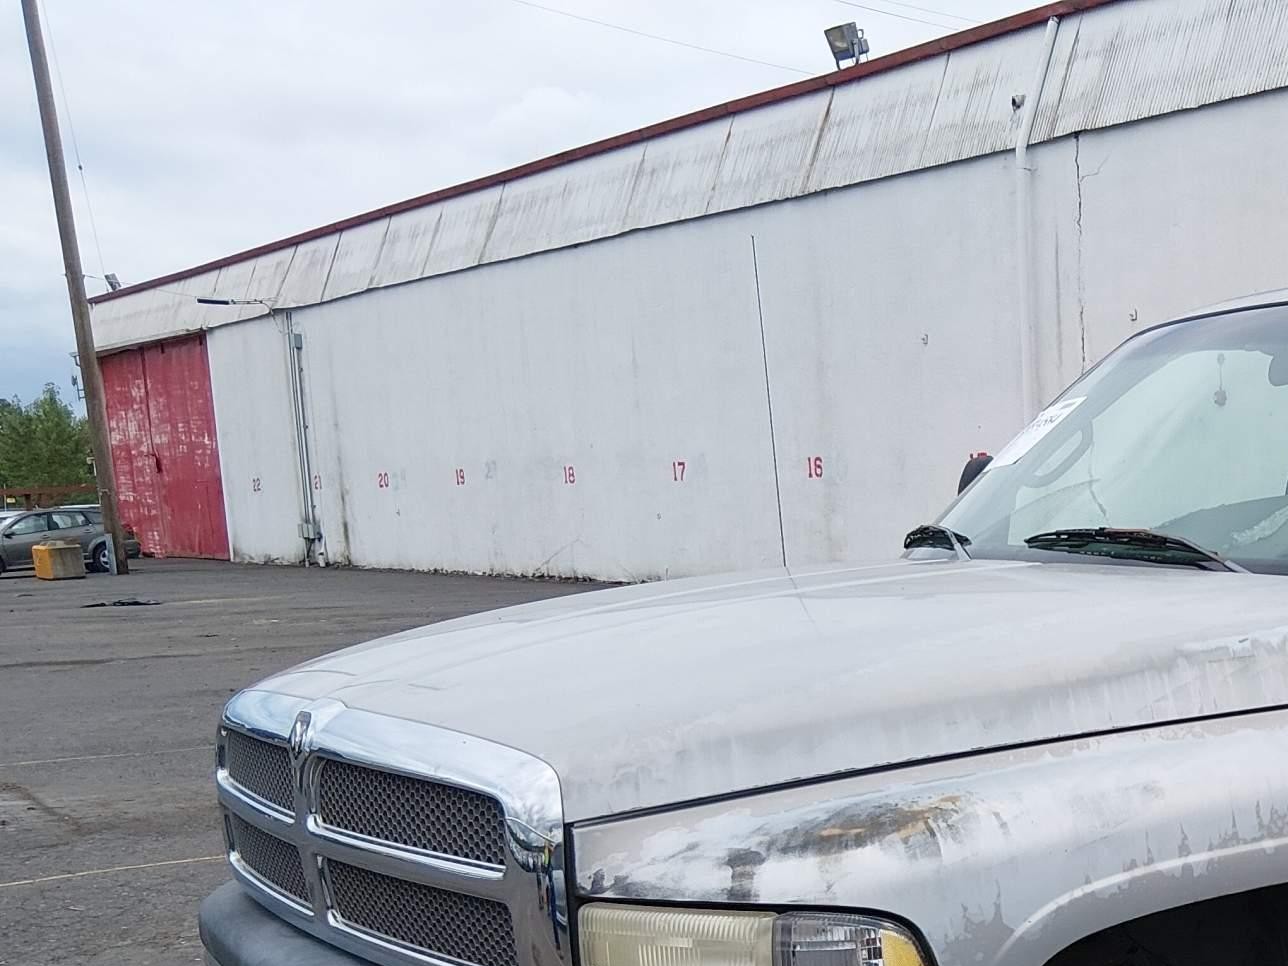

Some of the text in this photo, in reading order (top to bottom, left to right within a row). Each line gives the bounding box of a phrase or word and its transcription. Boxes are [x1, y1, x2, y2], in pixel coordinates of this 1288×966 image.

[563, 466, 576, 484] 18
[672, 461, 686, 482] 17
[807, 456, 823, 479] 16
[378, 472, 390, 488] 20
[455, 468, 466, 486] 19
